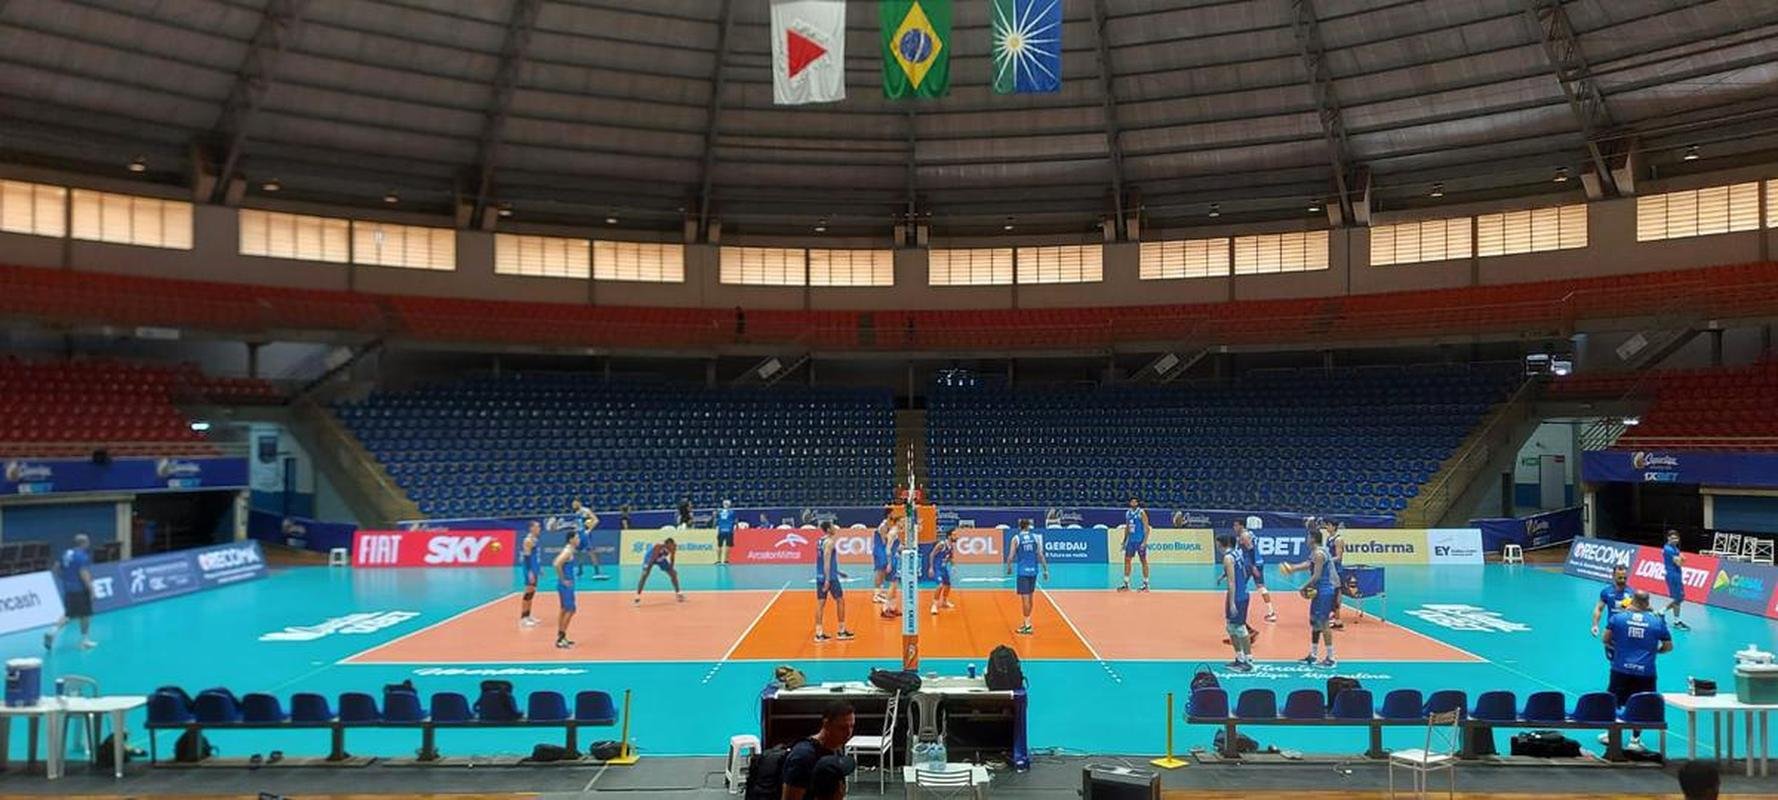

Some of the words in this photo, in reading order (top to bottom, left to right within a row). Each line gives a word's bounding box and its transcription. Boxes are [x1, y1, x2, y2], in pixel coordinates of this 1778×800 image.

[358, 535, 402, 564] FIAT
[424, 535, 492, 564] SKY
[955, 536, 999, 556] GOL
[1045, 541, 1088, 551] GERDAU
[1257, 536, 1305, 556] BET
[1344, 541, 1415, 554] urofarma
[1434, 546, 1451, 556] EY
[1584, 543, 1631, 568] RECOMA
[1635, 559, 1709, 588] LOREETTI
